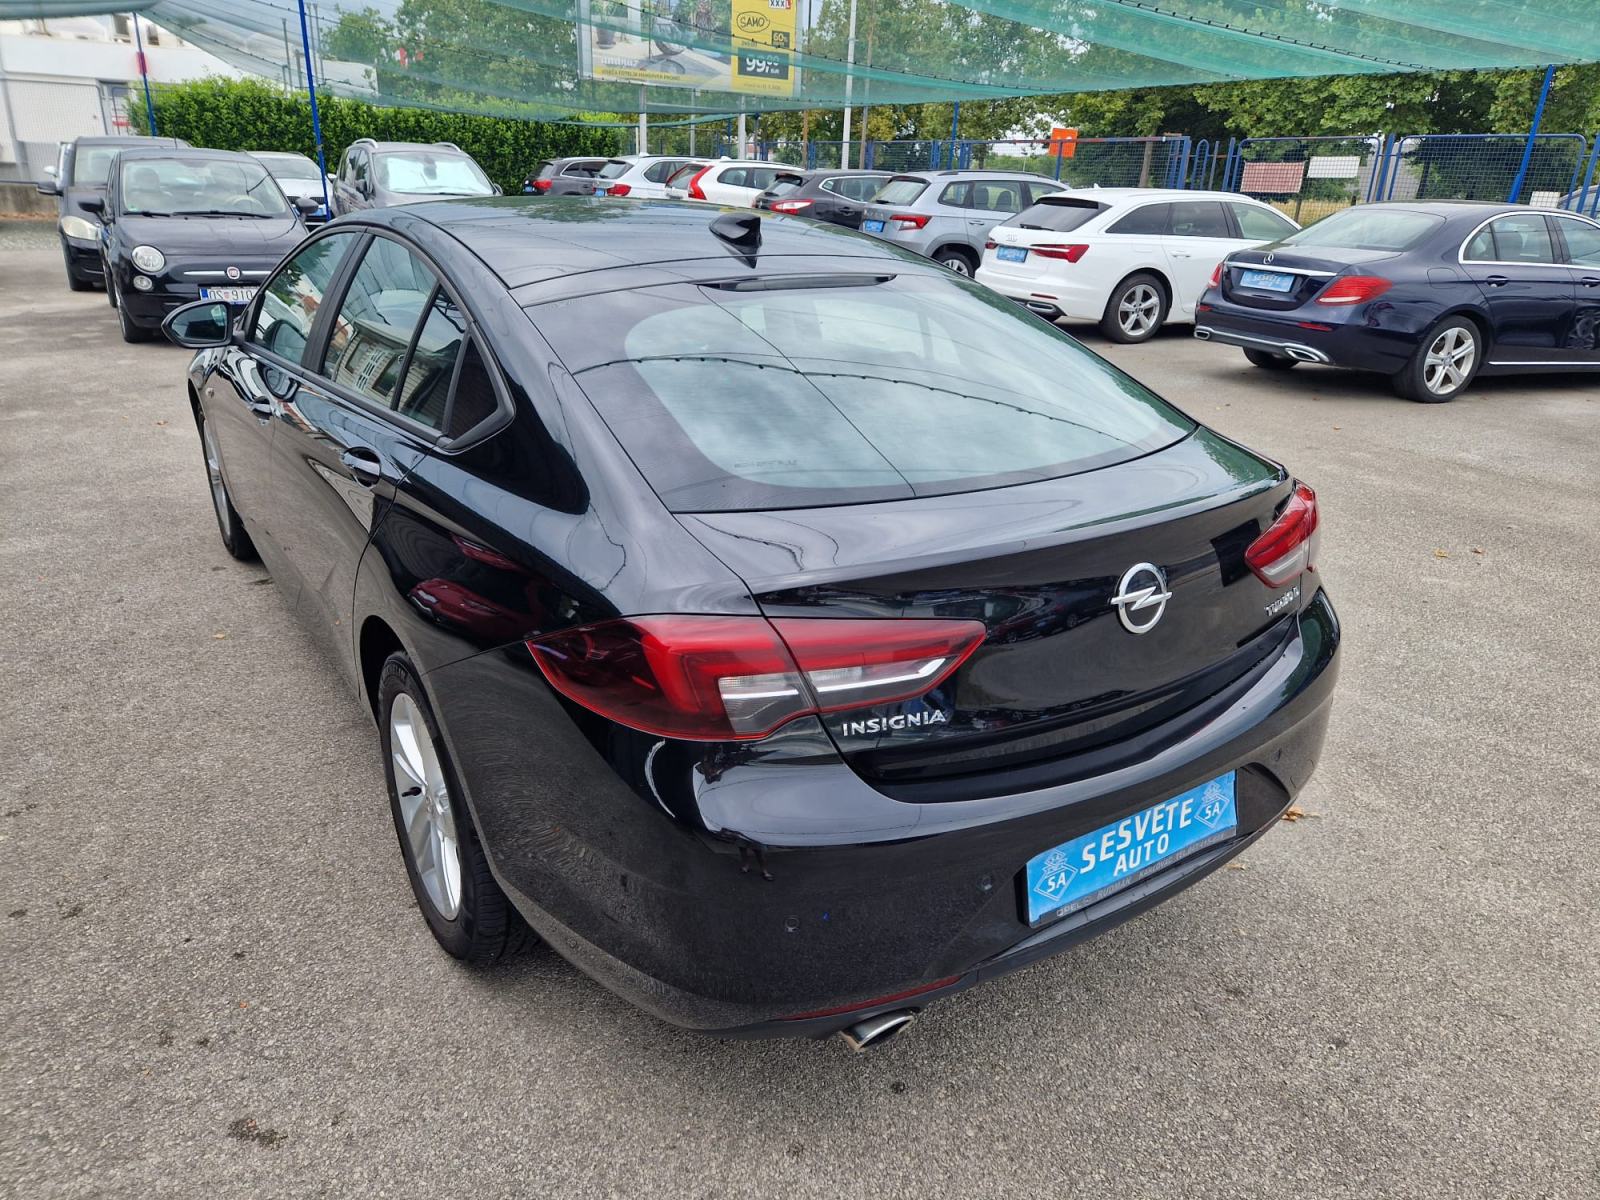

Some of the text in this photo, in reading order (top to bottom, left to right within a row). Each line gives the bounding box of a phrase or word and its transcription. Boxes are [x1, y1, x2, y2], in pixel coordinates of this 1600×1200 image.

[740, 16, 765, 28] SAMO
[231, 289, 253, 300] 910
[842, 709, 946, 736] INSIGNIA
[1204, 801, 1221, 820] SA
[1079, 798, 1195, 874] SESVETE
[1113, 833, 1169, 877] AUTO
[1047, 873, 1067, 893] SA
